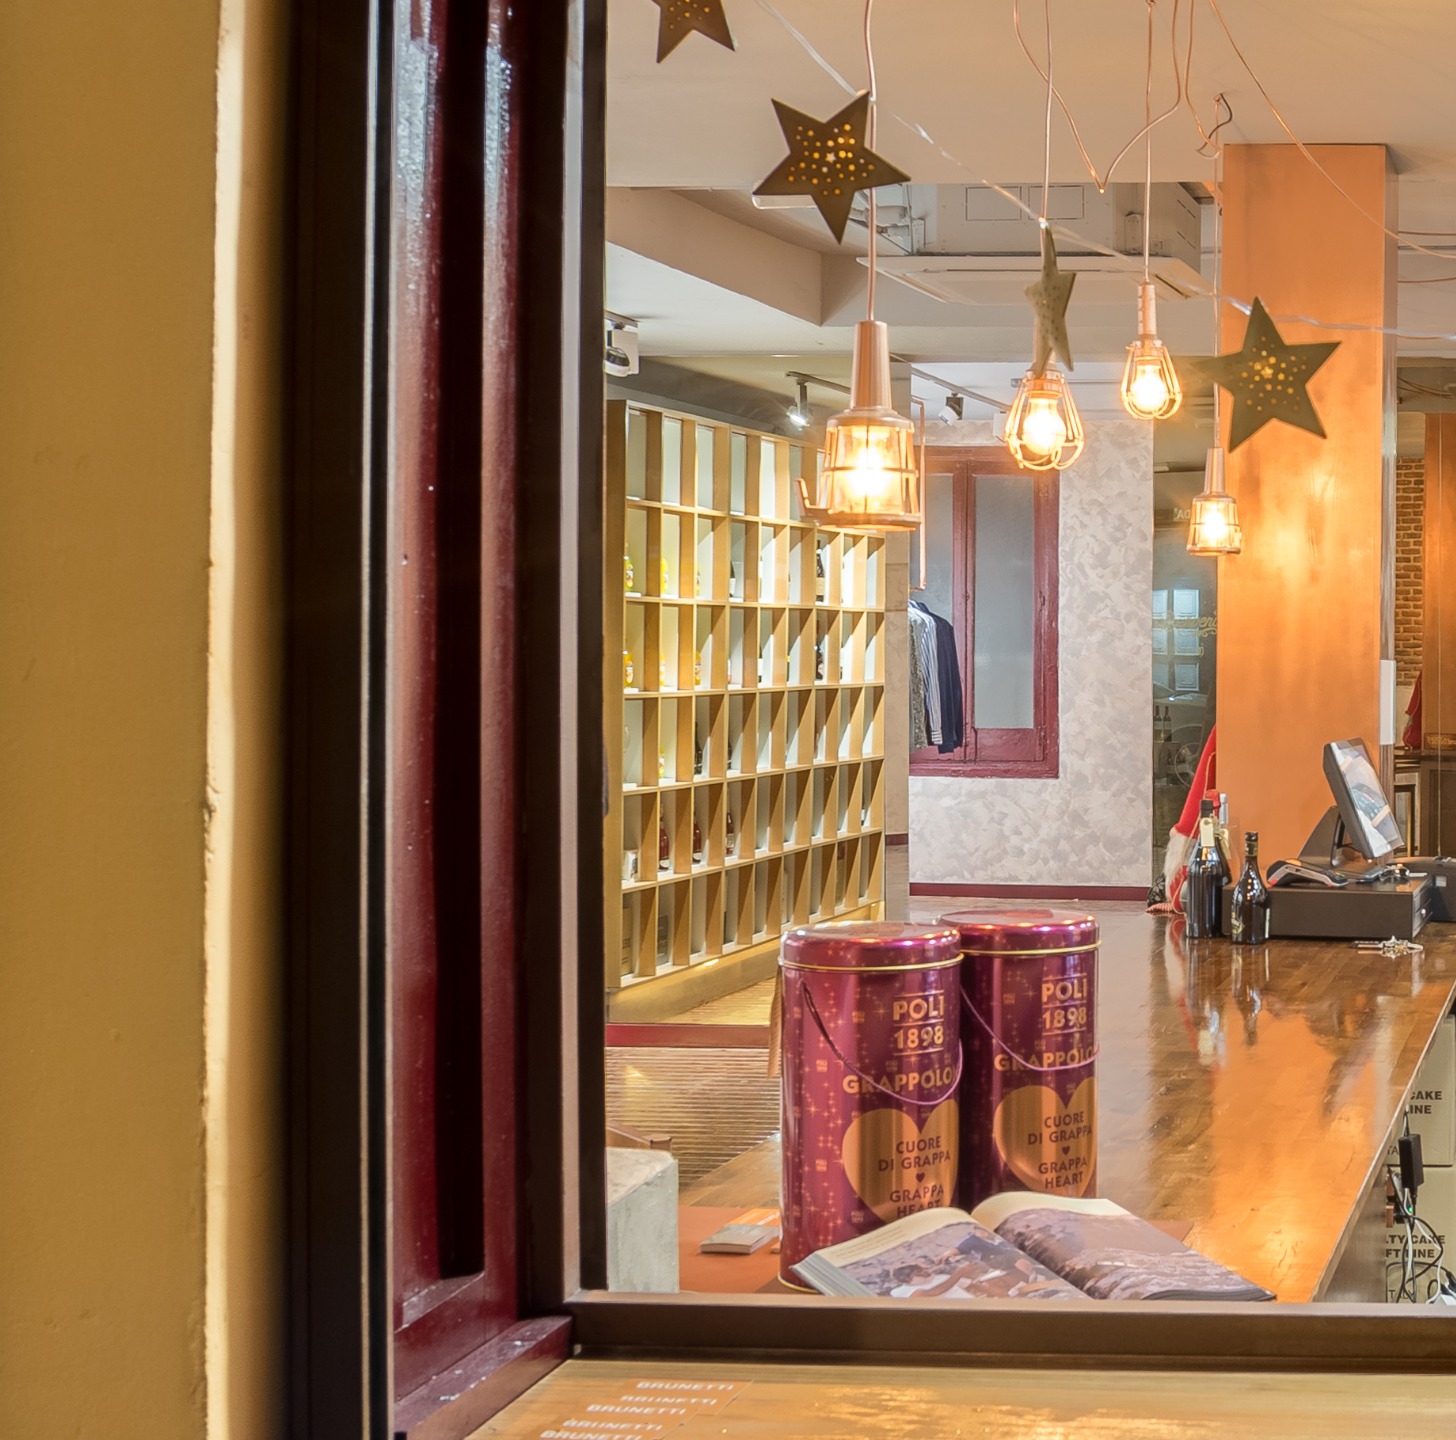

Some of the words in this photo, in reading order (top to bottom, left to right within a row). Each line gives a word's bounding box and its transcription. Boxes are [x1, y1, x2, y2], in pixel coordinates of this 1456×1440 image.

[1041, 978, 1088, 1003] POLI
[892, 994, 945, 1022] POLI
[1042, 1006, 1088, 1031] 1898
[893, 1025, 945, 1050] 1898
[1407, 1104, 1432, 1115] INE
[1043, 1111, 1085, 1130] CUORE
[895, 1135, 942, 1155] CUORE
[1027, 1133, 1043, 1146] DI
[1048, 1124, 1093, 1143] GRAPPA
[878, 1159, 895, 1172] DI
[900, 1150, 951, 1169] GRAPPA
[1037, 1156, 1089, 1175] GRAPPA
[1044, 1171, 1084, 1190] HEART
[889, 1183, 945, 1203] GRAPPA
[635, 1380, 734, 1391] BRUNETTI
[586, 1403, 687, 1416] BRUNETTI
